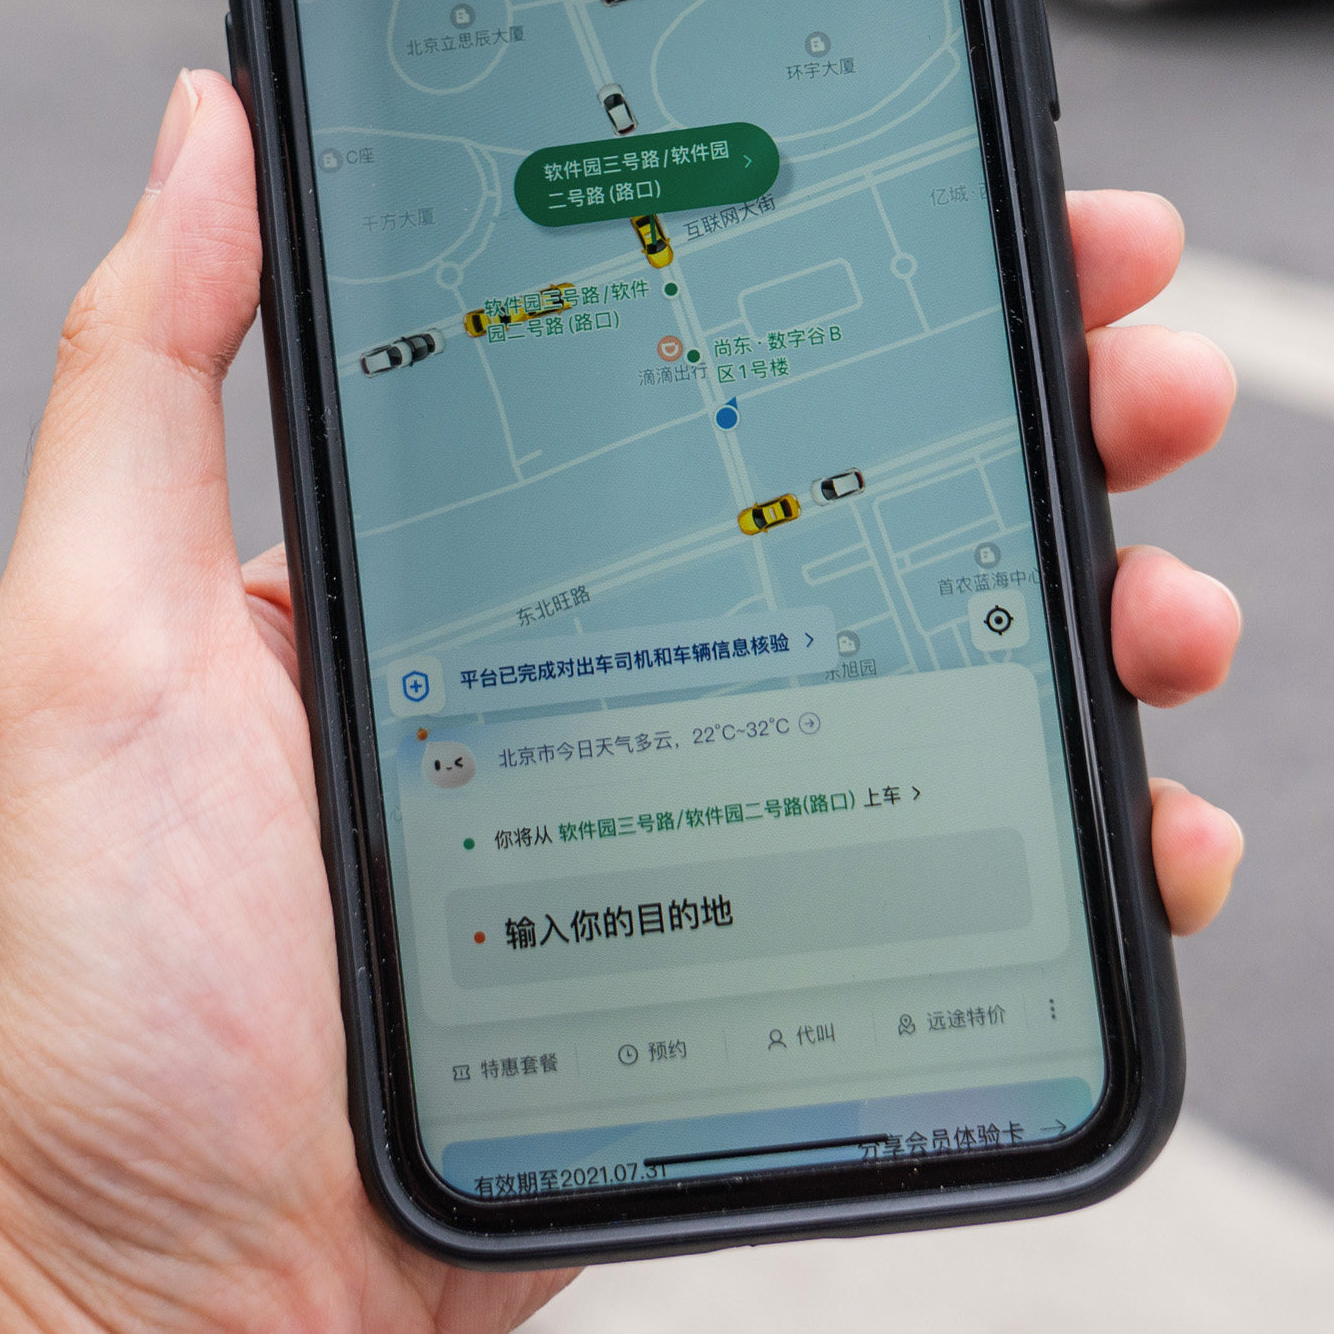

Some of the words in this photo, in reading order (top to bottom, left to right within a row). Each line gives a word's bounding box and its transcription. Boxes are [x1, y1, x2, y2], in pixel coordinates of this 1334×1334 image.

[406, 25, 526, 56] 北京立思辰大厦
[786, 57, 856, 81] 环宇大厦
[346, 147, 375, 164] C座
[544, 140, 730, 182] 软件园三号路/软件园
[548, 179, 661, 210] 二号路(路口)
[362, 207, 436, 231] 千方大厦
[683, 193, 776, 242] 互联网大街
[484, 279, 649, 317] 软件园三号路/软件
[487, 310, 620, 344] 园二号路(路口)
[638, 362, 708, 386] 滴滴出行
[717, 357, 790, 384] 区1号楼
[937, 567, 1041, 596] 首农蓝海中心
[516, 585, 590, 627] 东北旺路
[460, 632, 790, 690] 平台已完成对出车司机和车辆信息核验
[494, 824, 553, 850] 你将从
[558, 789, 856, 843] 软件园三号路/软件园二号路(路口)
[863, 785, 901, 808] 上车
[504, 893, 734, 951] 输入你的目的地
[927, 1004, 1006, 1032] 远途特价
[796, 1022, 836, 1046] 代叫
[480, 1052, 559, 1080] 特惠套餐
[647, 1039, 688, 1063] 预约
